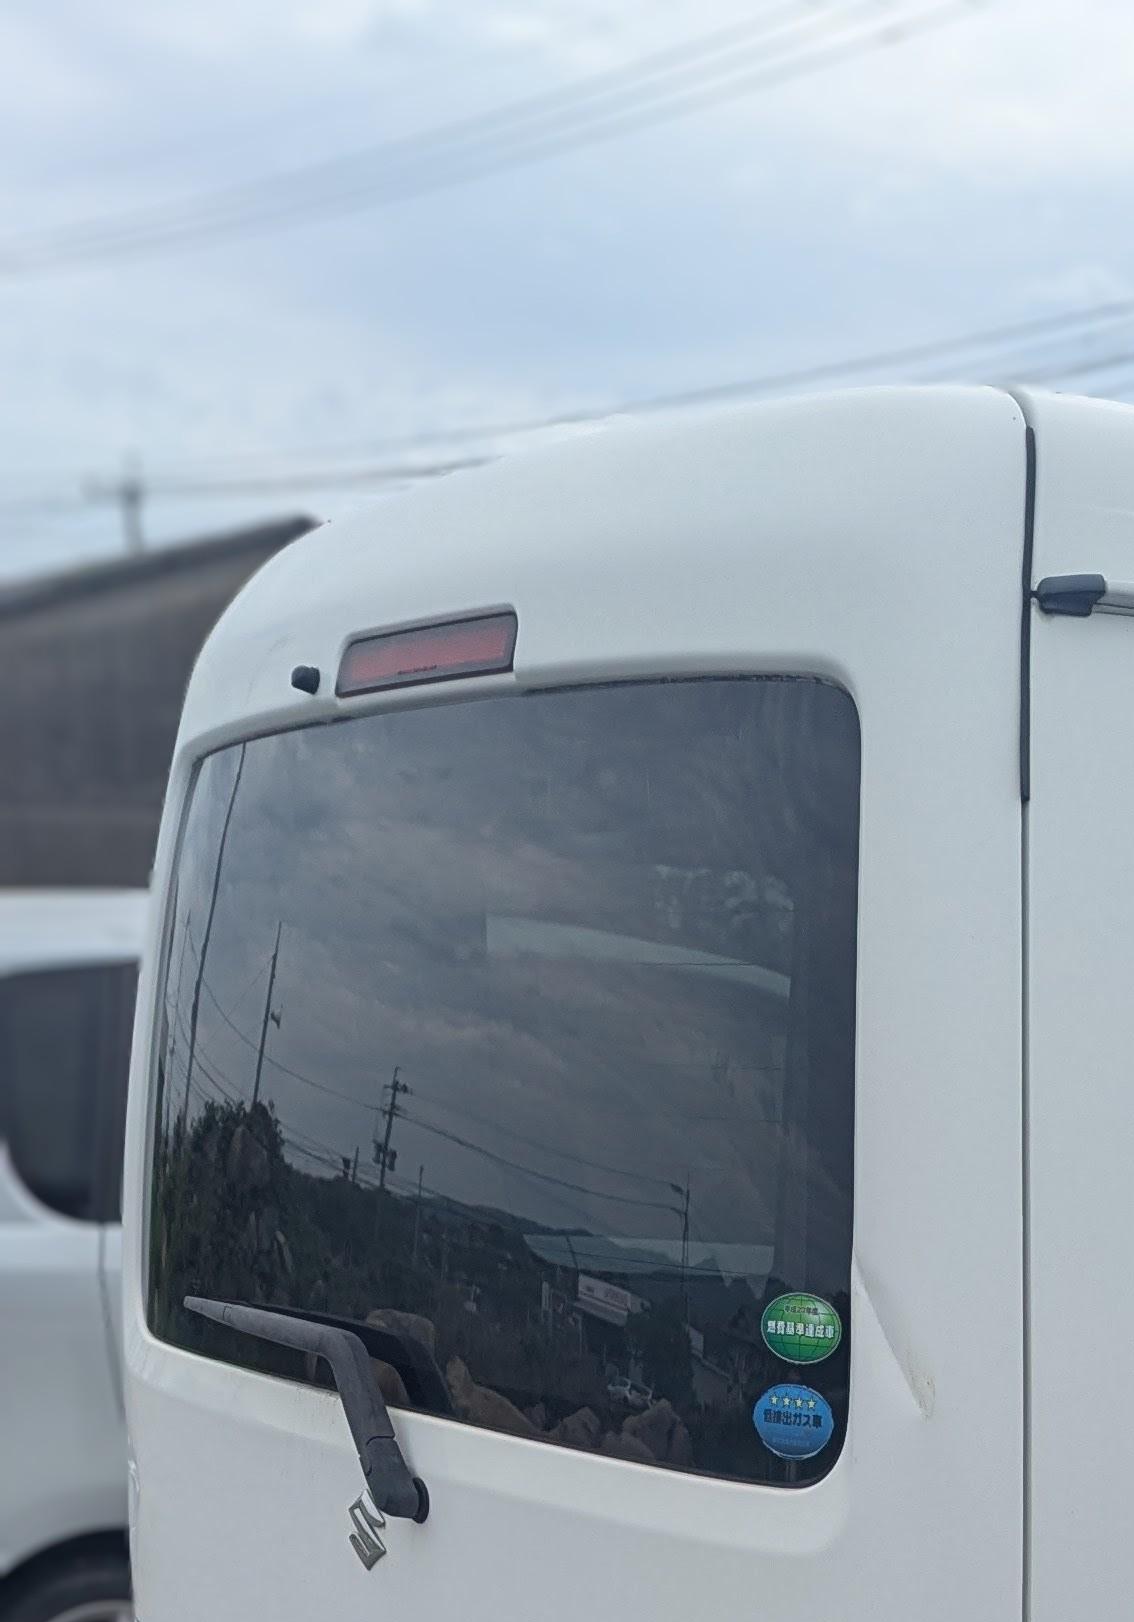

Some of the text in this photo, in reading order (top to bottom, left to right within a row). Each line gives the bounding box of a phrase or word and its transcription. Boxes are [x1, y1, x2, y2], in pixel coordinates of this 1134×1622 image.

[763, 1409, 823, 1429] 低排出ガス車
